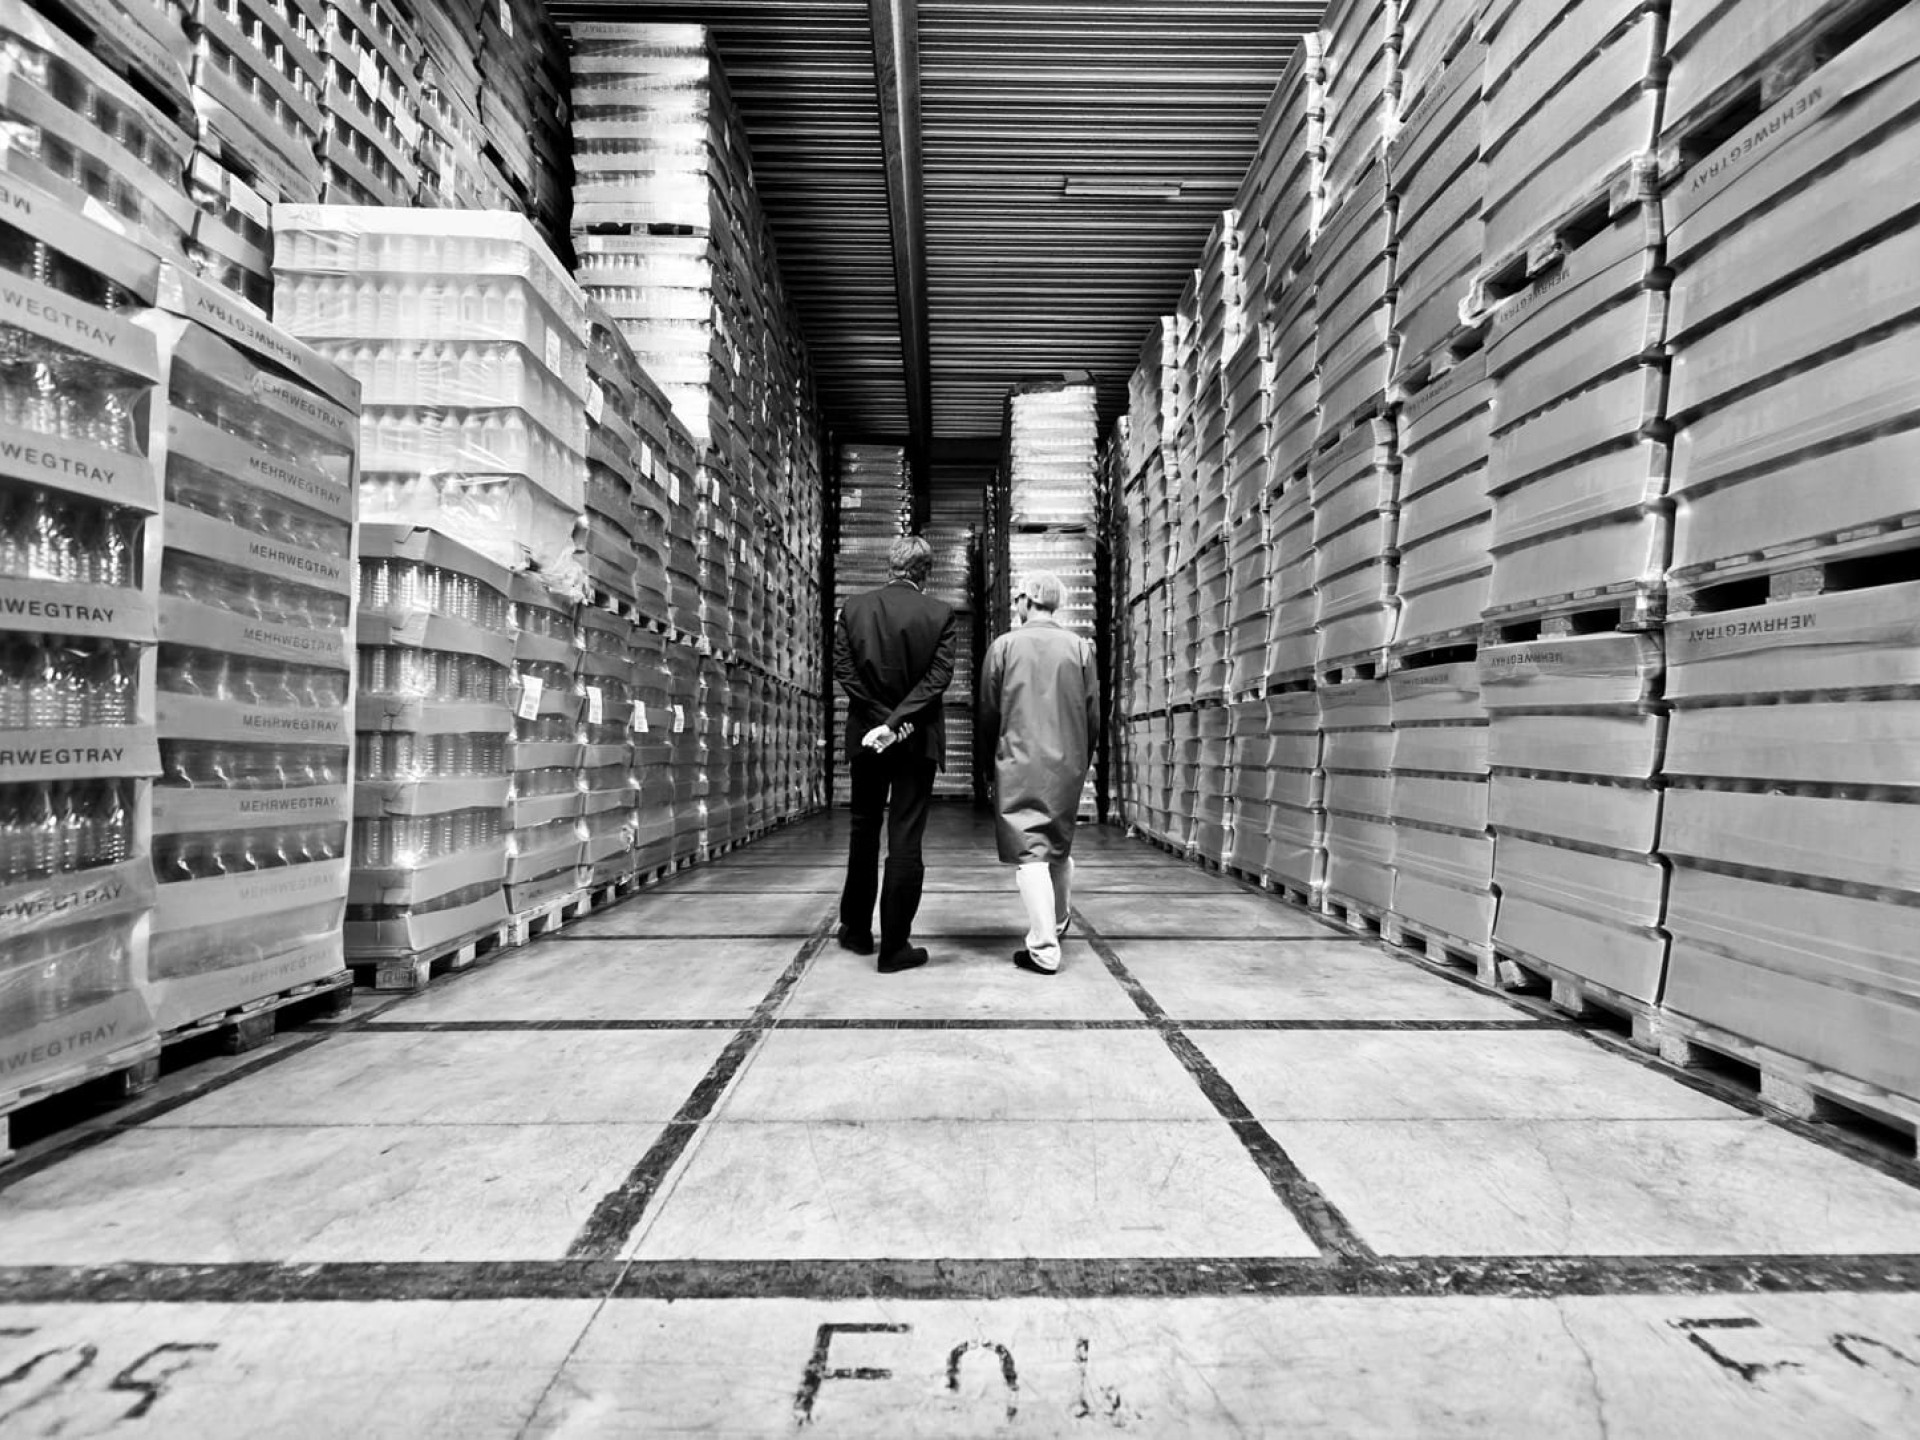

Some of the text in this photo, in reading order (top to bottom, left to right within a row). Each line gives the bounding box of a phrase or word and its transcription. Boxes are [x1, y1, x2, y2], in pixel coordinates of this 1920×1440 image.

[1691, 86, 1823, 192] MEHRWEGTRAY
[197, 297, 302, 365] MEHRWEGTRAY
[249, 456, 340, 504] MEHRWEGTRAY
[249, 541, 340, 579] MEHRWEGTRAY
[0, 597, 114, 622] WEGTRAY
[244, 628, 339, 653] MEHRWEGTRAY
[1688, 613, 1817, 643] MEHRWEGTRAY
[242, 715, 338, 732] MEHRWEGTRAY
[240, 796, 336, 812] MEHRWEGTRAY
[0, 1020, 118, 1075] WEGTRAY
